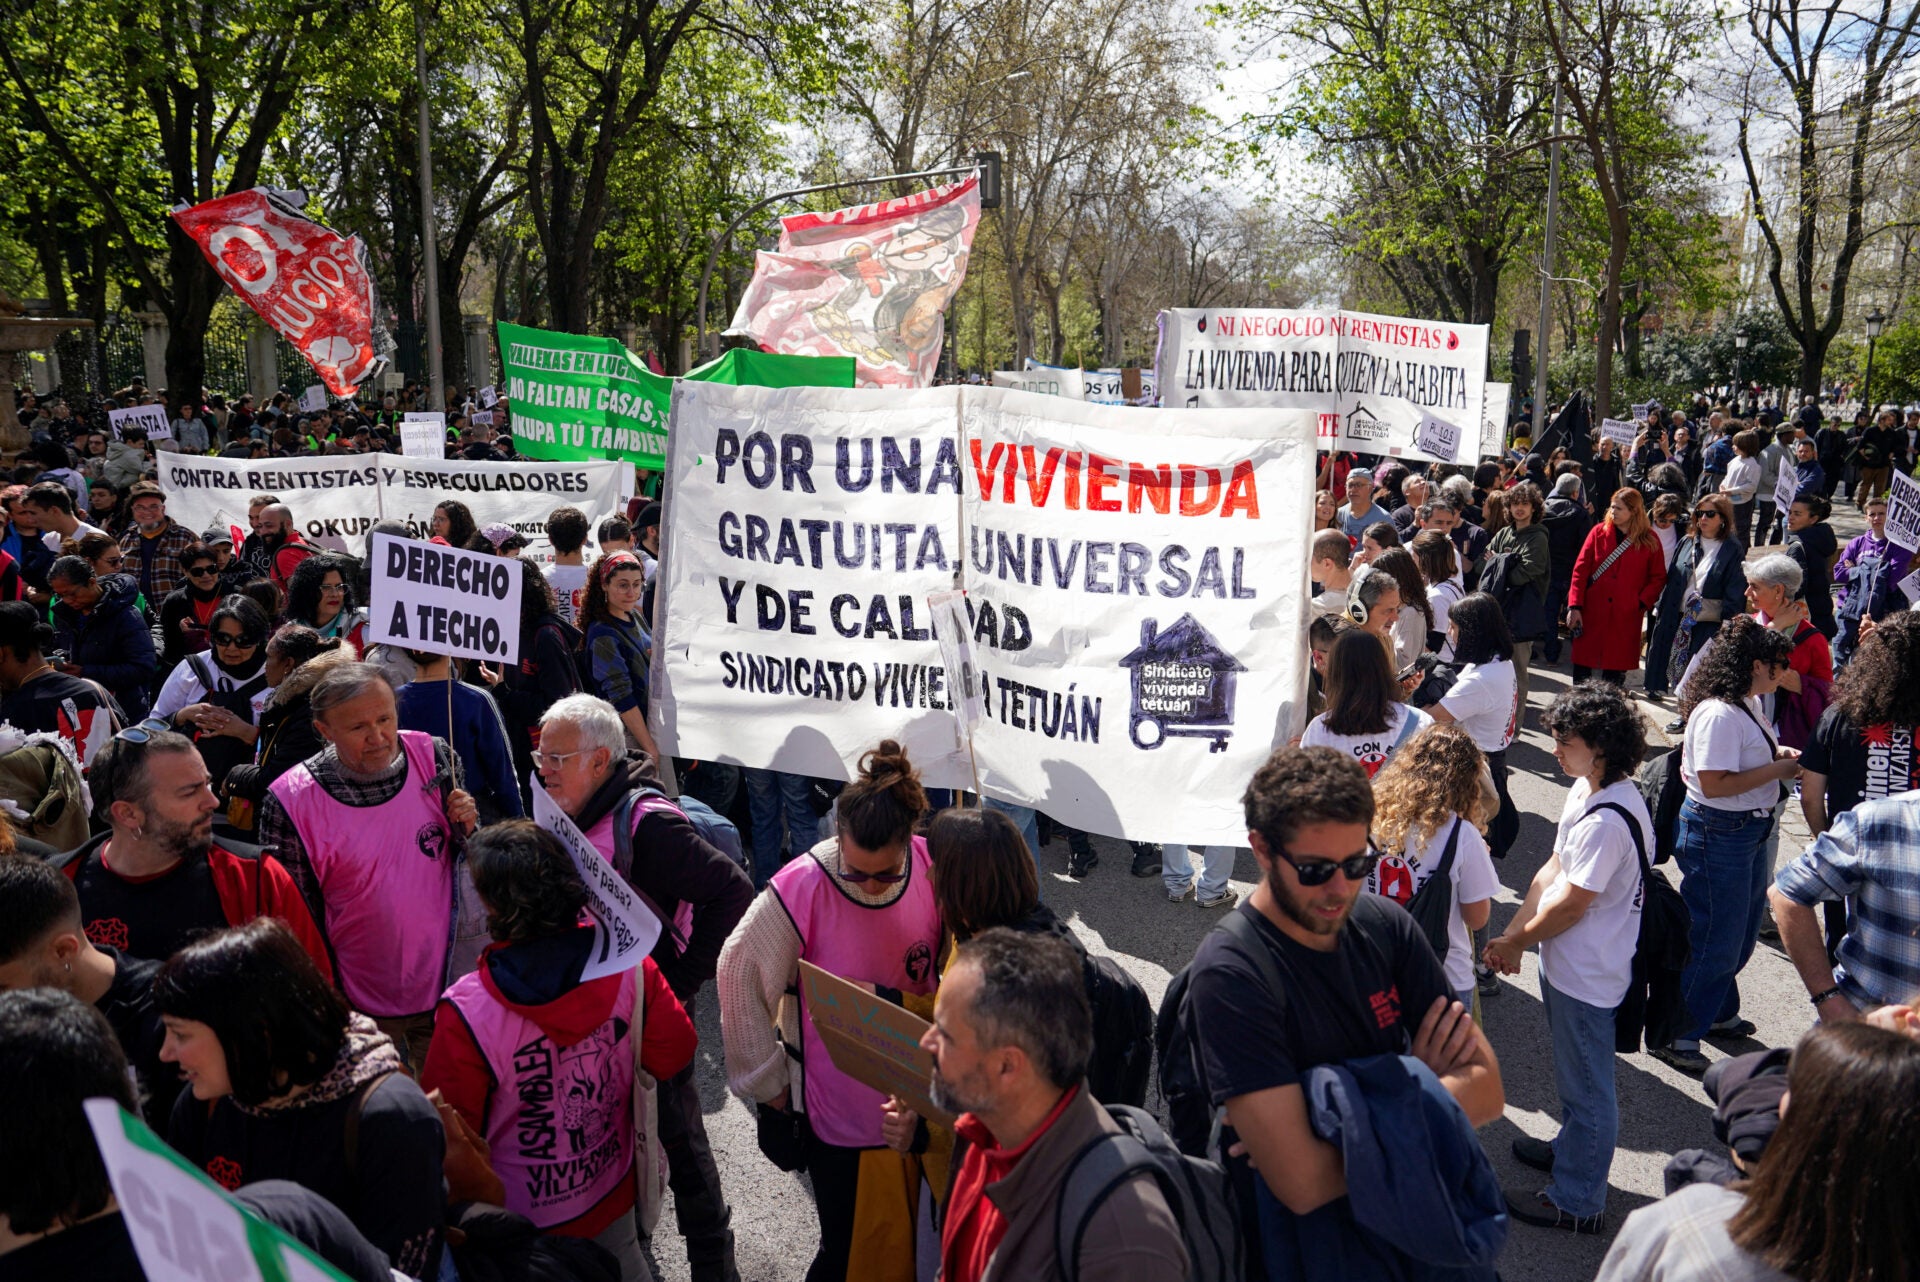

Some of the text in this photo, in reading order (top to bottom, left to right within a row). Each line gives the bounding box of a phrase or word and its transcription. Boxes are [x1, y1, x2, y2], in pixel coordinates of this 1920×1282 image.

[1216, 316, 1441, 350] NI NEGOCIO NI RENTISTAS
[573, 351, 595, 373] EN
[1185, 349, 1205, 389] LA
[1210, 349, 1287, 392] VIVIENDA
[1288, 351, 1332, 392] PARA
[1335, 351, 1382, 402] QUIEN
[1380, 358, 1402, 398] LA
[1405, 362, 1467, 409] HABITA
[510, 376, 525, 402] NO
[527, 380, 591, 410] FALTAN
[596, 387, 658, 428] CASAS,
[512, 412, 556, 445] OKUPA
[560, 420, 585, 447] TÚ
[171, 467, 589, 493] CONTRA RENTISTAS Y ESPECULADORES
[716, 428, 1261, 520] POR UNA VIVIENDA
[386, 541, 509, 600] DERECHO
[718, 511, 1257, 600] GRATUITA, UNIVERSAL
[388, 600, 508, 657] A TECHO.
[718, 576, 1033, 652] Y DE CALAD
[719, 650, 867, 702] SINDICATO
[997, 682, 1102, 744] TETUÁN
[1141, 698, 1191, 712] tetuán
[1142, 681, 1206, 696] vivienda
[1353, 742, 1380, 757] CON
[581, 846, 599, 878] qué
[600, 870, 632, 911] pasa?
[1407, 854, 1422, 872] EL
[513, 1036, 557, 1160] ASAMBLEA
